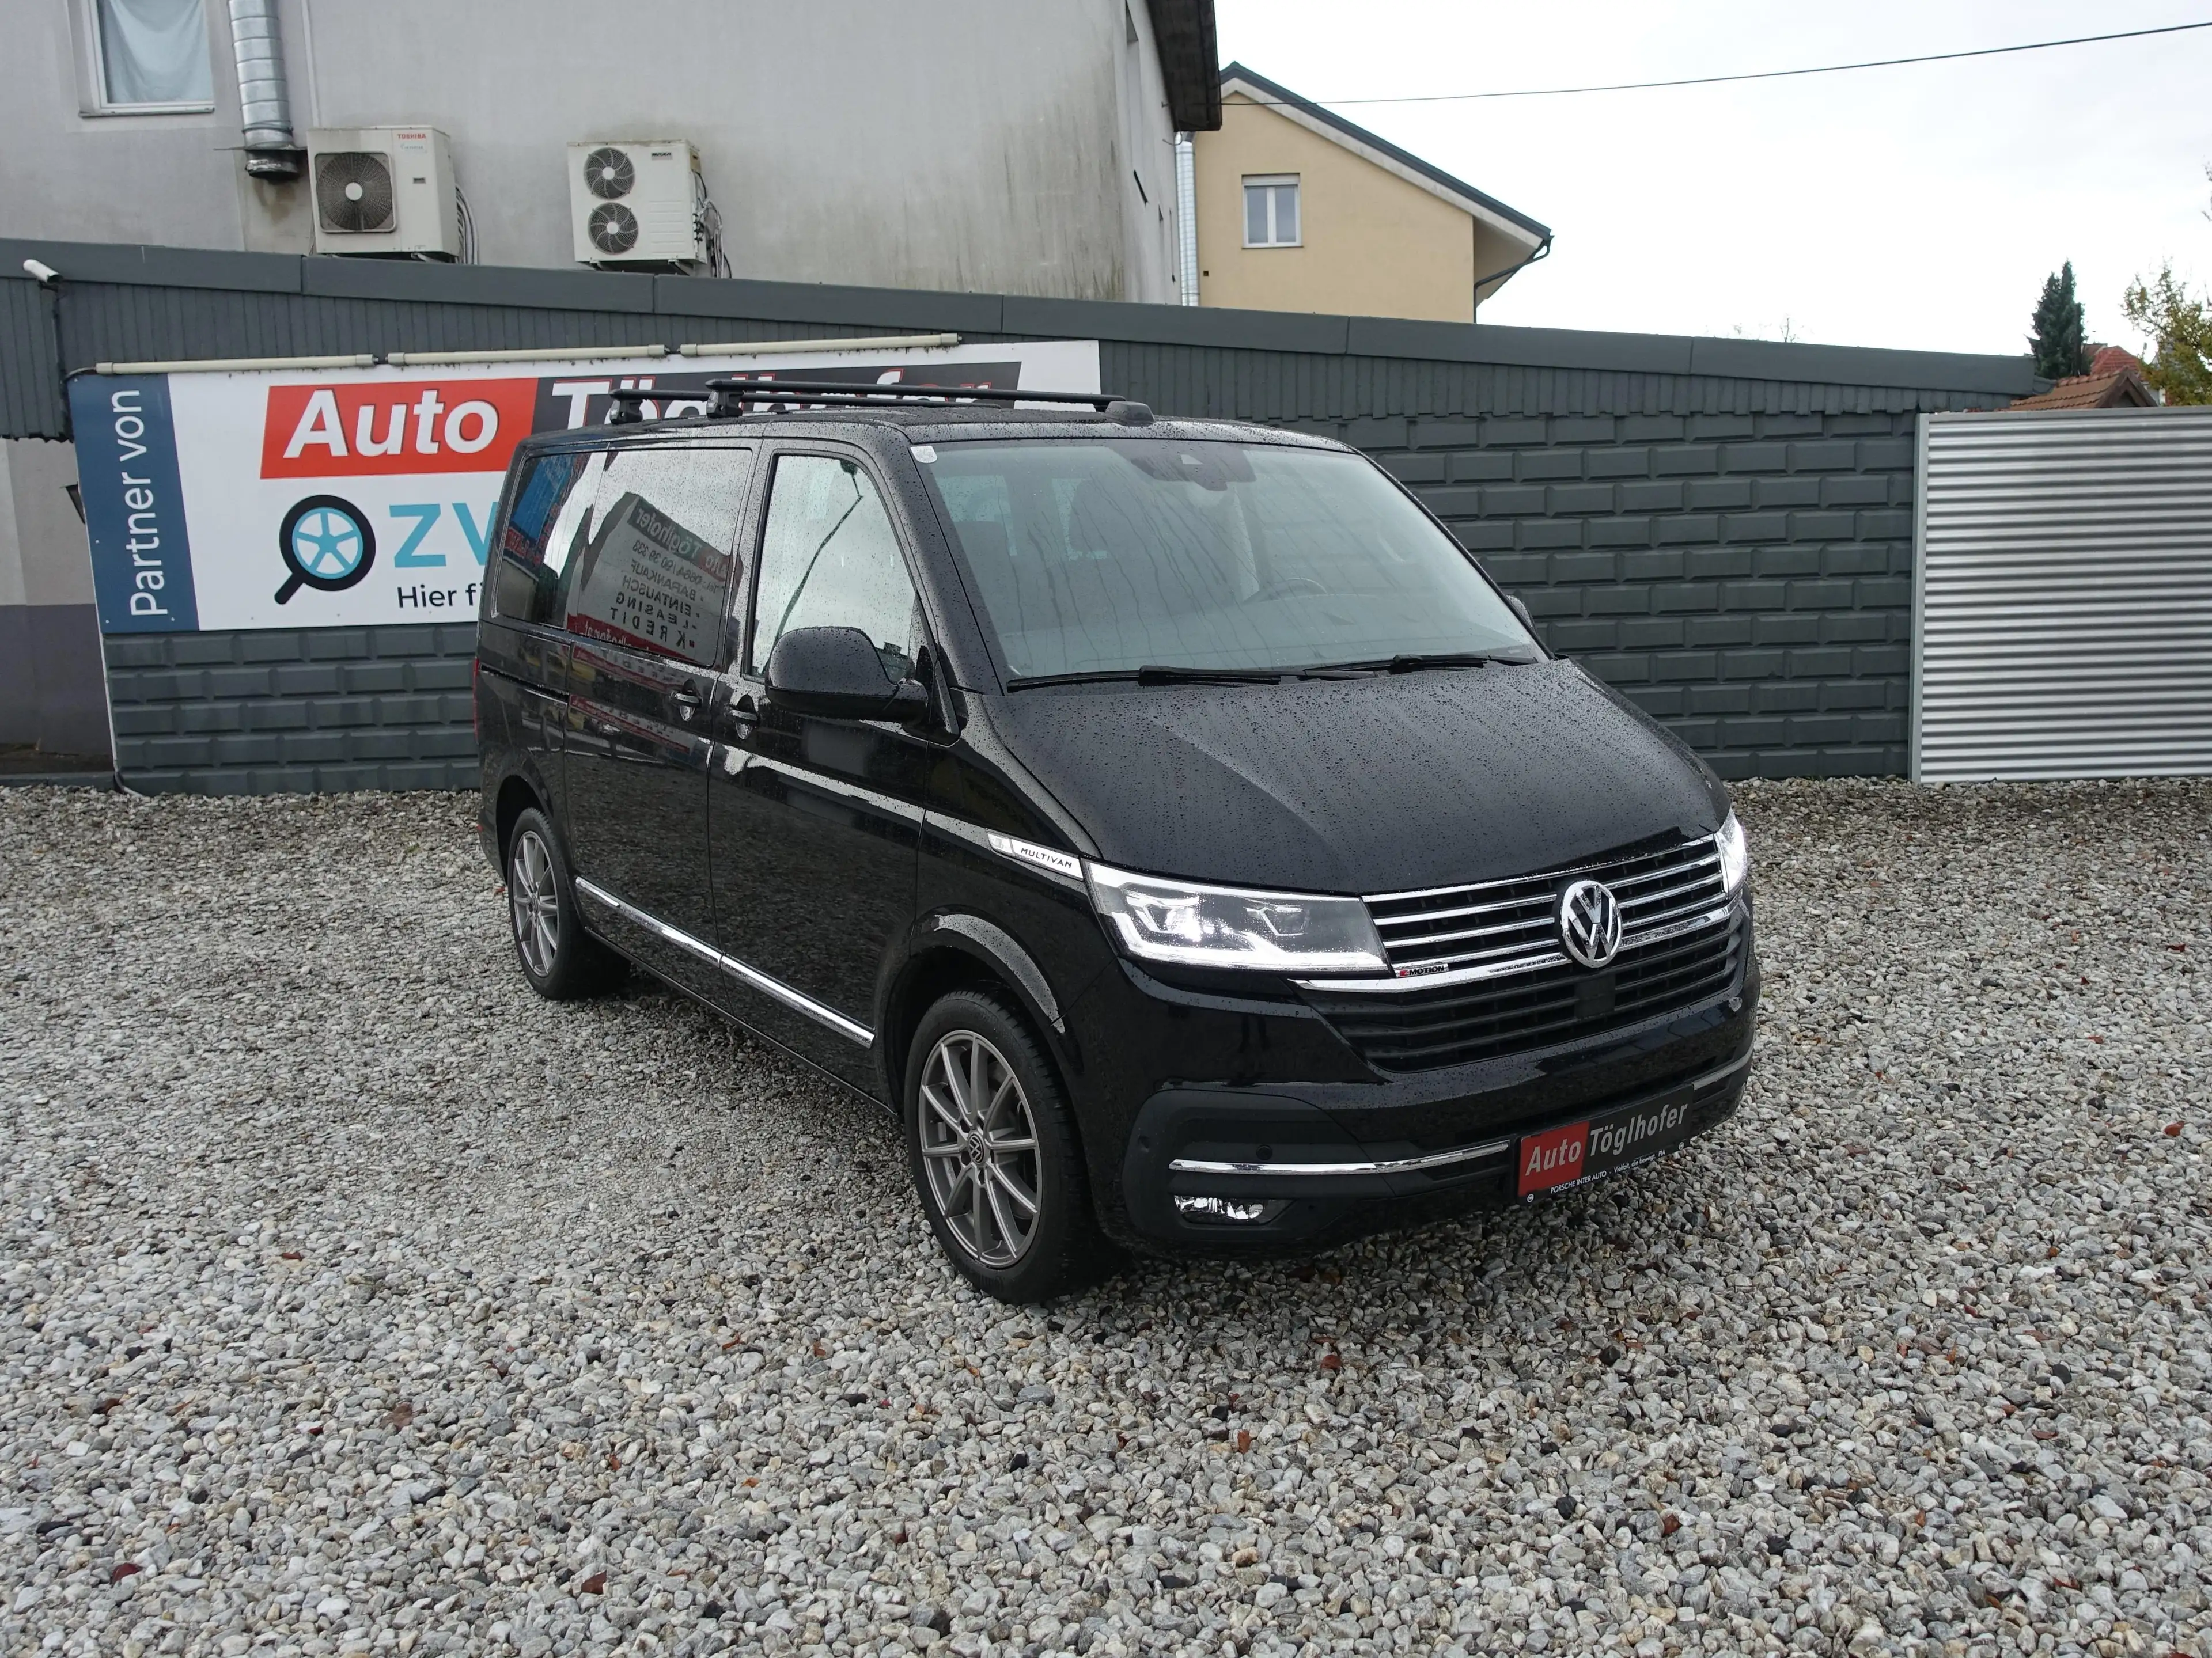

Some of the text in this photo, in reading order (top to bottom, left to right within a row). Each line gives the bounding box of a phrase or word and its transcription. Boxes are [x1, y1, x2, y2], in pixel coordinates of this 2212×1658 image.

[283, 388, 499, 458] Auto
[112, 390, 168, 616] Partner von
[397, 582, 483, 608] Hier f
[1021, 847, 1072, 868] MULTIVAN
[1525, 1103, 1688, 1176] Auto Töglhofer
[1550, 1180, 1575, 1194] PORSCHE
[1577, 1175, 1592, 1185] INTER
[1592, 1170, 1607, 1180] AUTO
